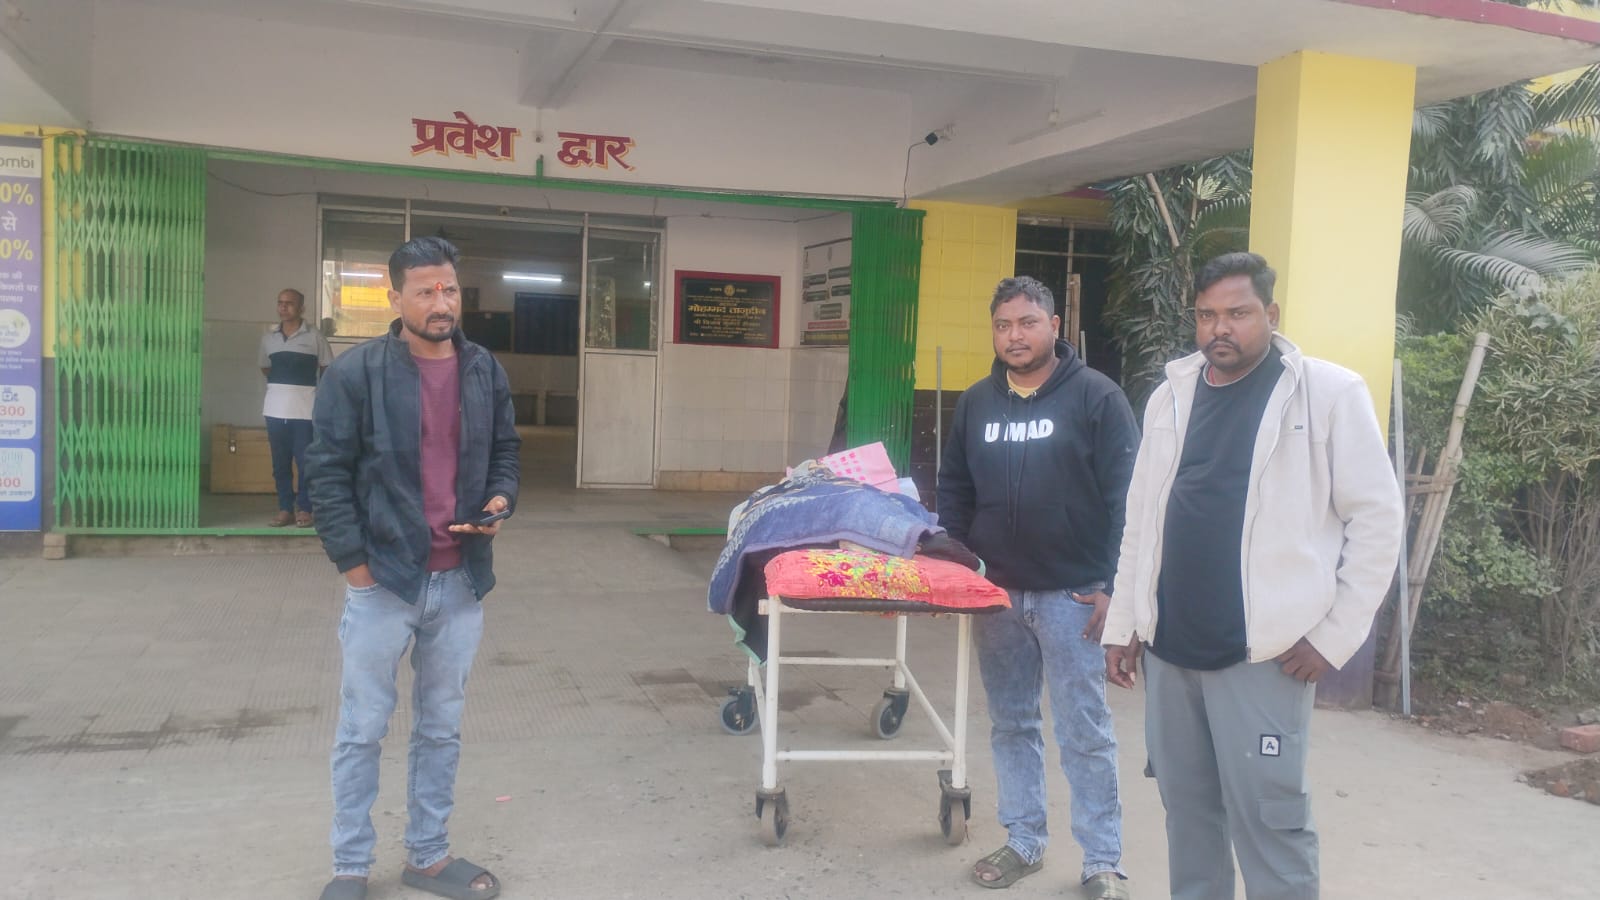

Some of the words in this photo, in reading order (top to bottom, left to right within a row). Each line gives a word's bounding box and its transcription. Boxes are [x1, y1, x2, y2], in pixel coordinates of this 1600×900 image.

[411, 111, 521, 162] प्रवेश
[557, 131, 636, 171] द्वार
[0, 210, 17, 231] से
[985, 422, 1000, 442] U
